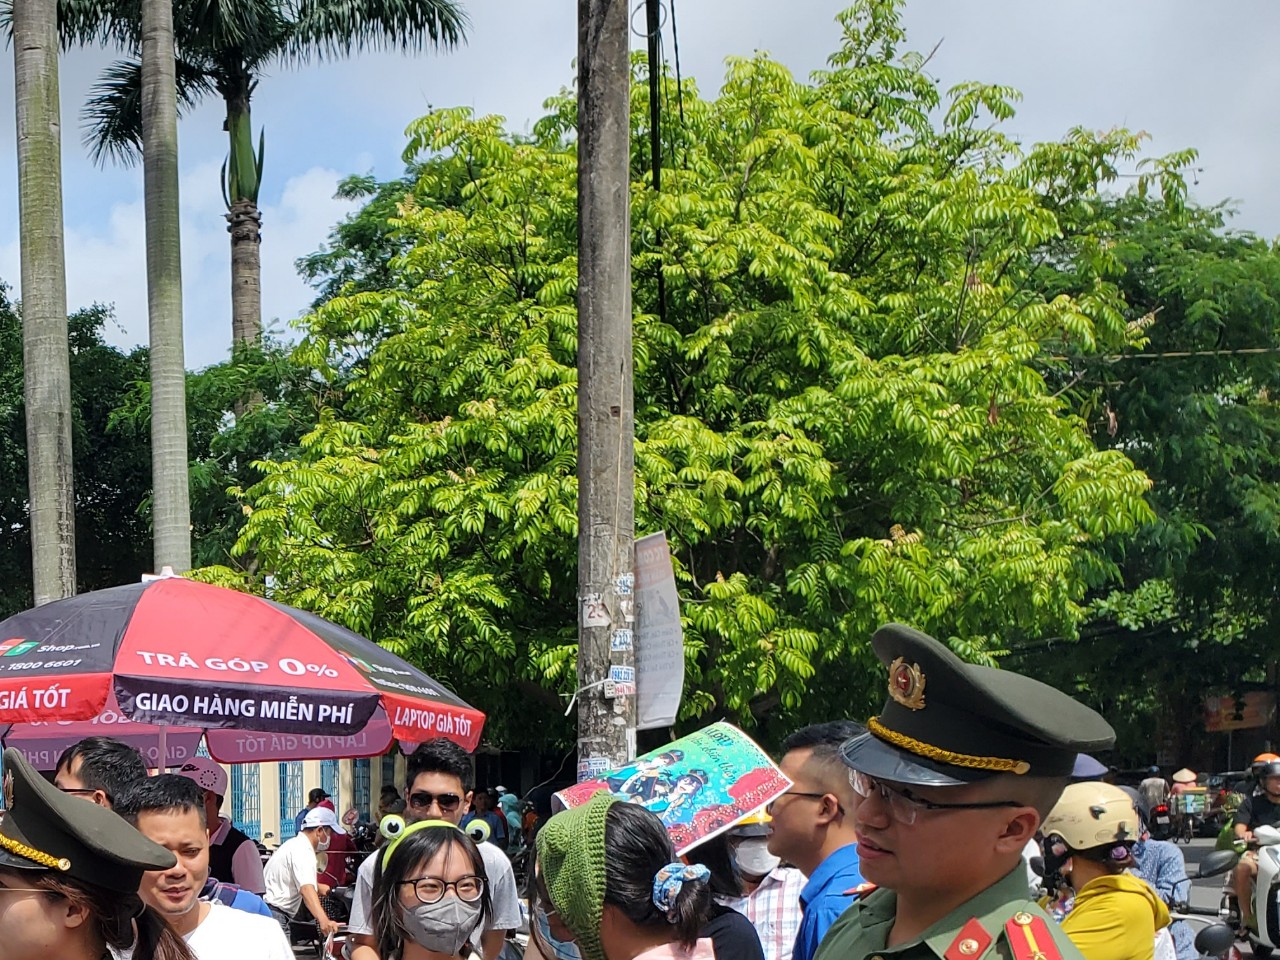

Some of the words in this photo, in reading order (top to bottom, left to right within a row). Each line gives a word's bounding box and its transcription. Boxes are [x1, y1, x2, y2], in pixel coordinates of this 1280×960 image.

[7, 661, 42, 671] 1800
[43, 659, 81, 668] 6601
[137, 651, 199, 669] TRẢ
[205, 658, 268, 673] GÓP
[279, 658, 338, 678] 0%
[32, 683, 71, 708] TỐT
[135, 692, 189, 713] GIAO
[193, 695, 256, 718] HÀNG
[260, 696, 314, 721] MIỄN
[318, 703, 355, 725] PHÍ
[394, 706, 436, 730] LAPTOP
[436, 712, 453, 734] GIÁ
[454, 713, 472, 737] TỐT
